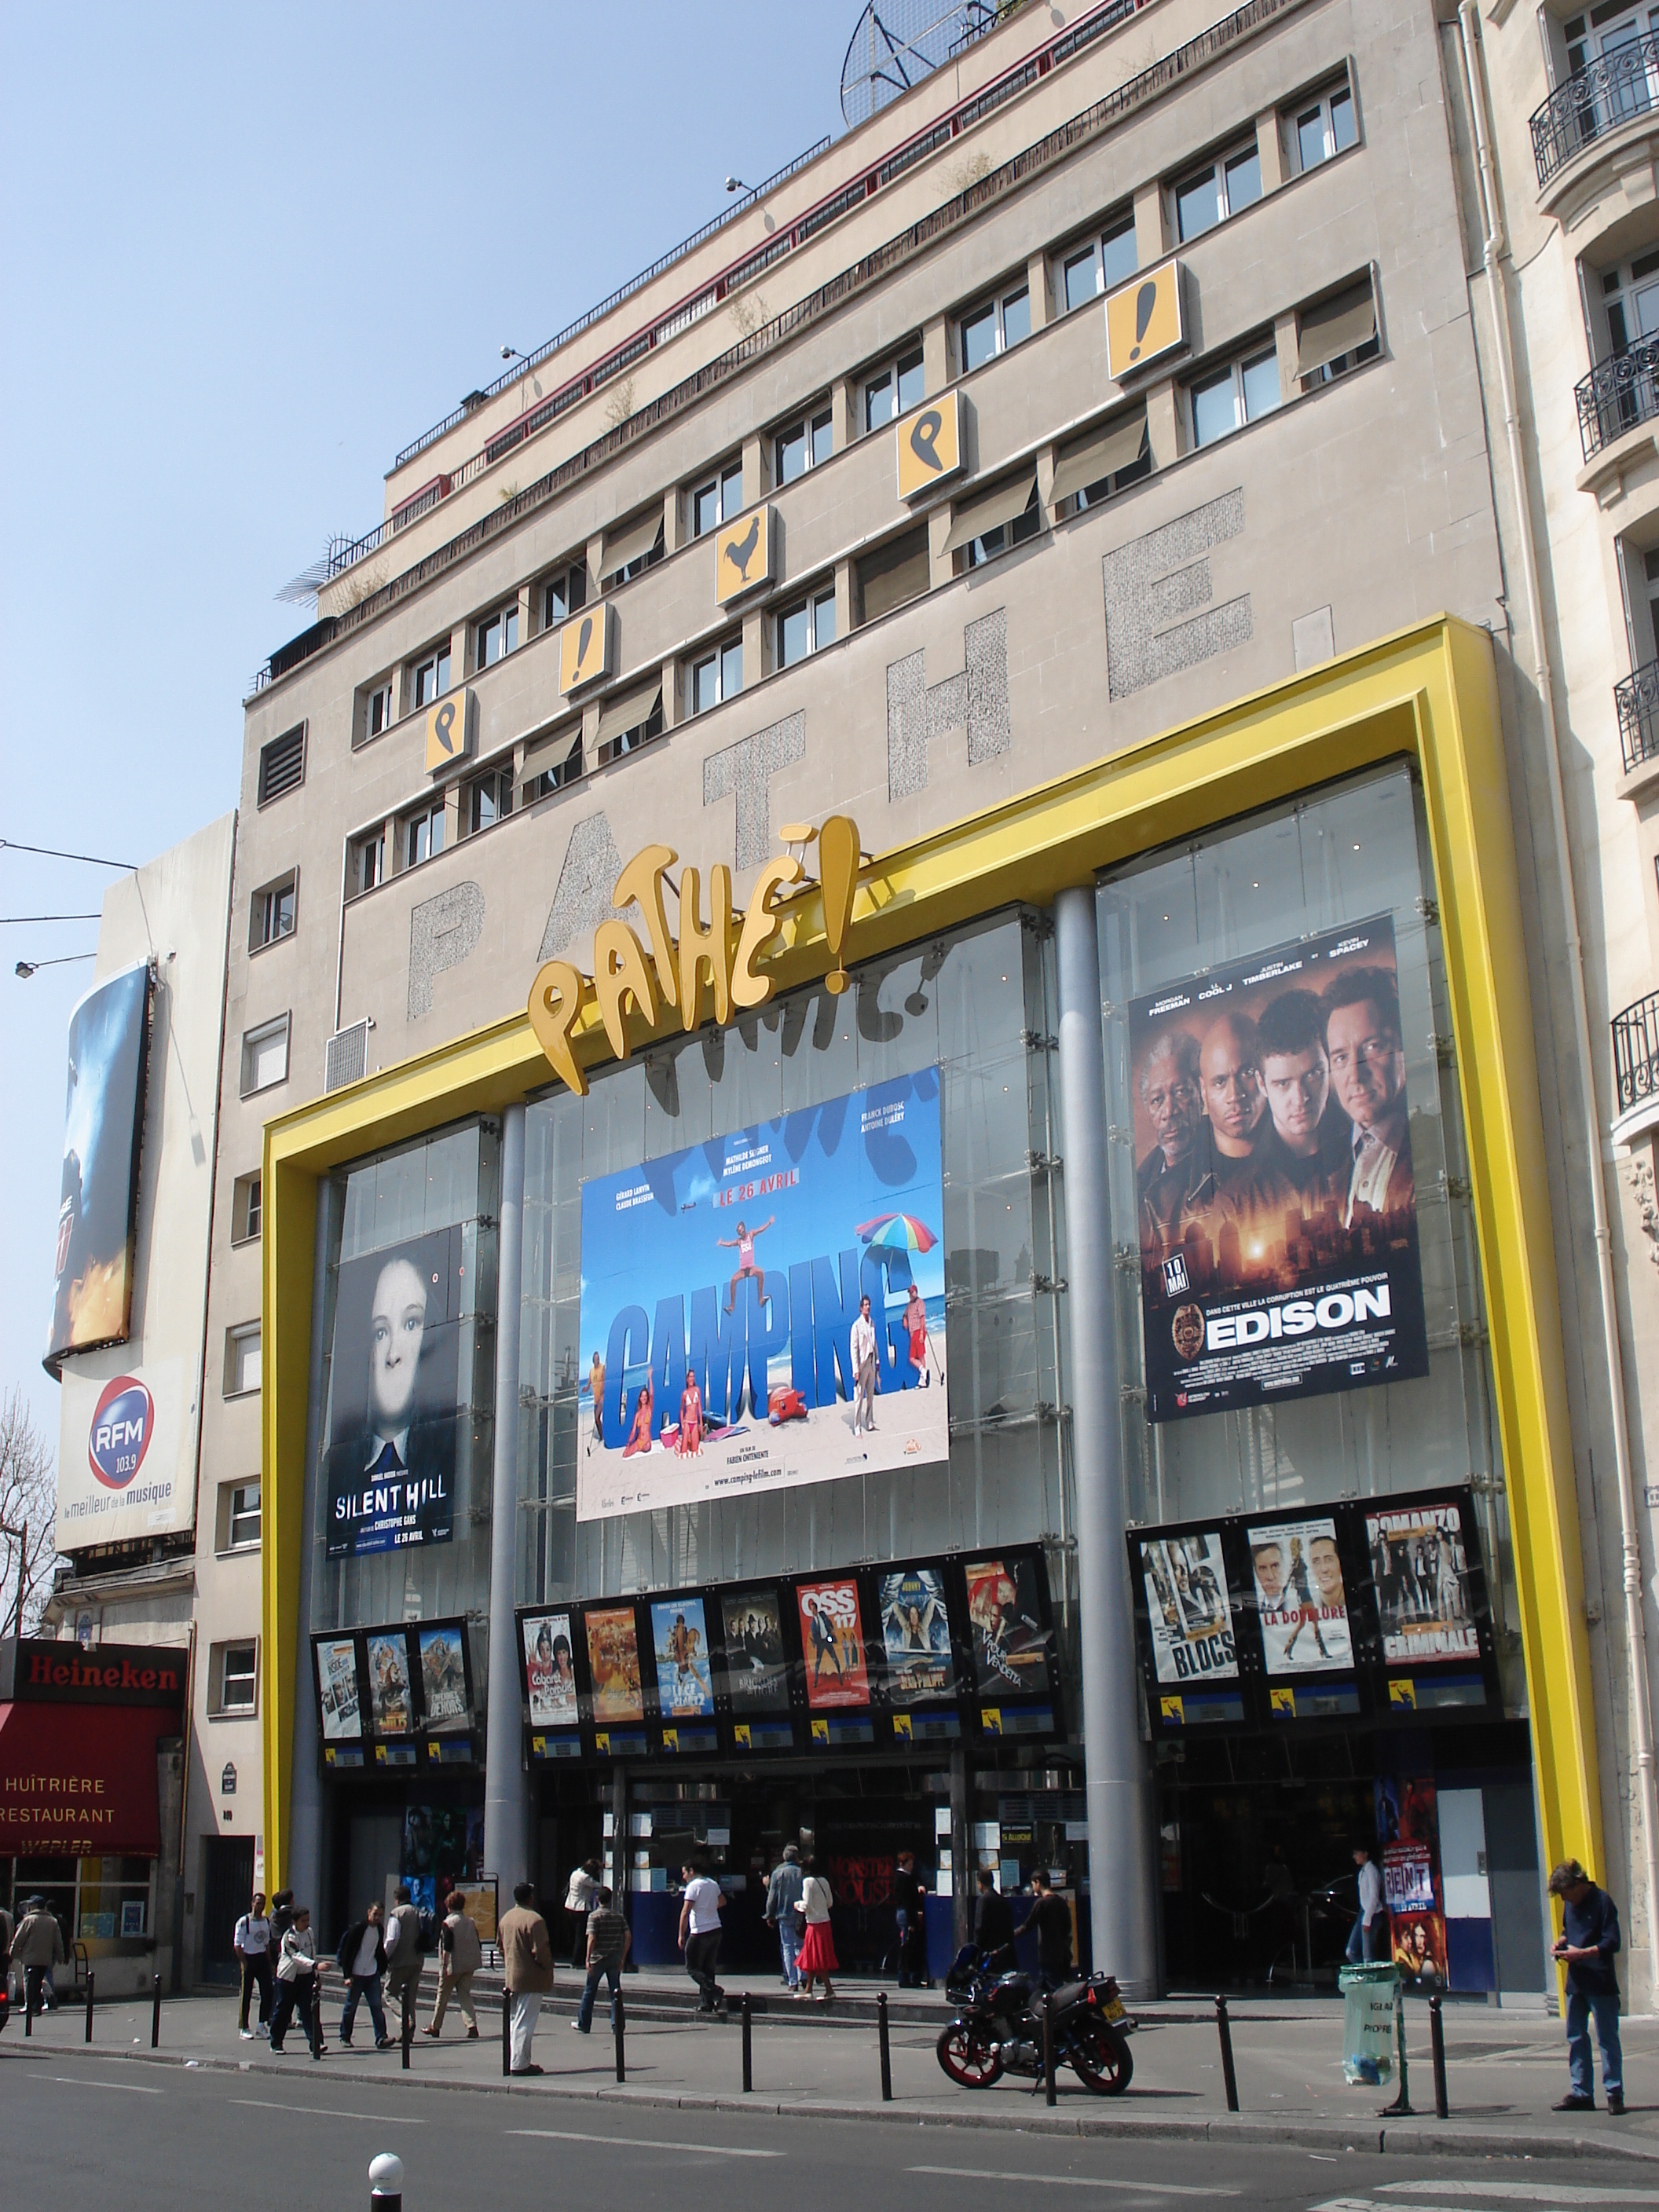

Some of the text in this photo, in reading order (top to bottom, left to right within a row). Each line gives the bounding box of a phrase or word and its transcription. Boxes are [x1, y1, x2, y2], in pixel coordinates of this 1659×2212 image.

[1329, 939, 1369, 958] SPACEY
[1338, 937, 1360, 947] KEVIN
[1243, 961, 1303, 986] TIMBERLAKE
[1260, 961, 1284, 974] JUSTIN
[1155, 994, 1184, 1008] MORGAN
[1199, 983, 1233, 1001] COOL J
[1148, 998, 1191, 1017] FREEMAN
[861, 1101, 905, 1122] FRANCK DUBOSC
[861, 1118, 884, 1133] ANTOINE
[726, 1151, 749, 1166] MATHILDE
[742, 1153, 772, 1171] DEMONGEOT
[634, 1184, 650, 1196] LANVIN
[720, 1170, 797, 1207] LE 26 AVRIL
[616, 1192, 654, 1211] CLAUDE BRASSEUR
[1166, 1258, 1181, 1277] 10
[1167, 1273, 1187, 1294] MAI
[1206, 1272, 1389, 1317] DANS CETTE VILLE LA CORRUPTION EST LE QUATRIÈME POUVOIR
[1206, 1284, 1392, 1351] EDISON
[603, 1241, 921, 1450] CAMPING
[95, 1417, 144, 1452] RFM
[115, 1454, 137, 1474] 103.9
[714, 1467, 782, 1486] www.camping-lefilm.com
[64, 1481, 172, 1519] le meilleur de la musique
[335, 1474, 447, 1520] SILENT HILL
[375, 1516, 403, 1531] CHRISTOPHE
[403, 1514, 416, 1525] GANS
[1365, 1507, 1461, 1542] ROMANZO
[394, 1534, 401, 1544] LE
[401, 1533, 408, 1543] 26
[408, 1530, 423, 1542] AVRIL
[801, 1588, 856, 1618] OSS
[833, 1613, 857, 1629] 117
[1264, 1610, 1278, 1626] LA
[983, 1628, 1008, 1662] V POUR
[1384, 1628, 1480, 1658] CRIMINALE
[1172, 1630, 1238, 1679] BLOCS
[29, 1655, 179, 1690] Heineken
[531, 1670, 562, 1686] Cabaret
[987, 1650, 1022, 1688] VENDETTA
[430, 1698, 464, 1718] DEHORS
[698, 1692, 705, 1706] 2
[5, 1774, 105, 1793] HUÎTRIÈRE
[0, 1808, 115, 1823] RESTAURANT
[20, 1840, 93, 1855] WEPLER
[827, 1854, 895, 1878] MONSTER
[1385, 1867, 1426, 1895] RENT
[1408, 1903, 1427, 1911] AVRIL
